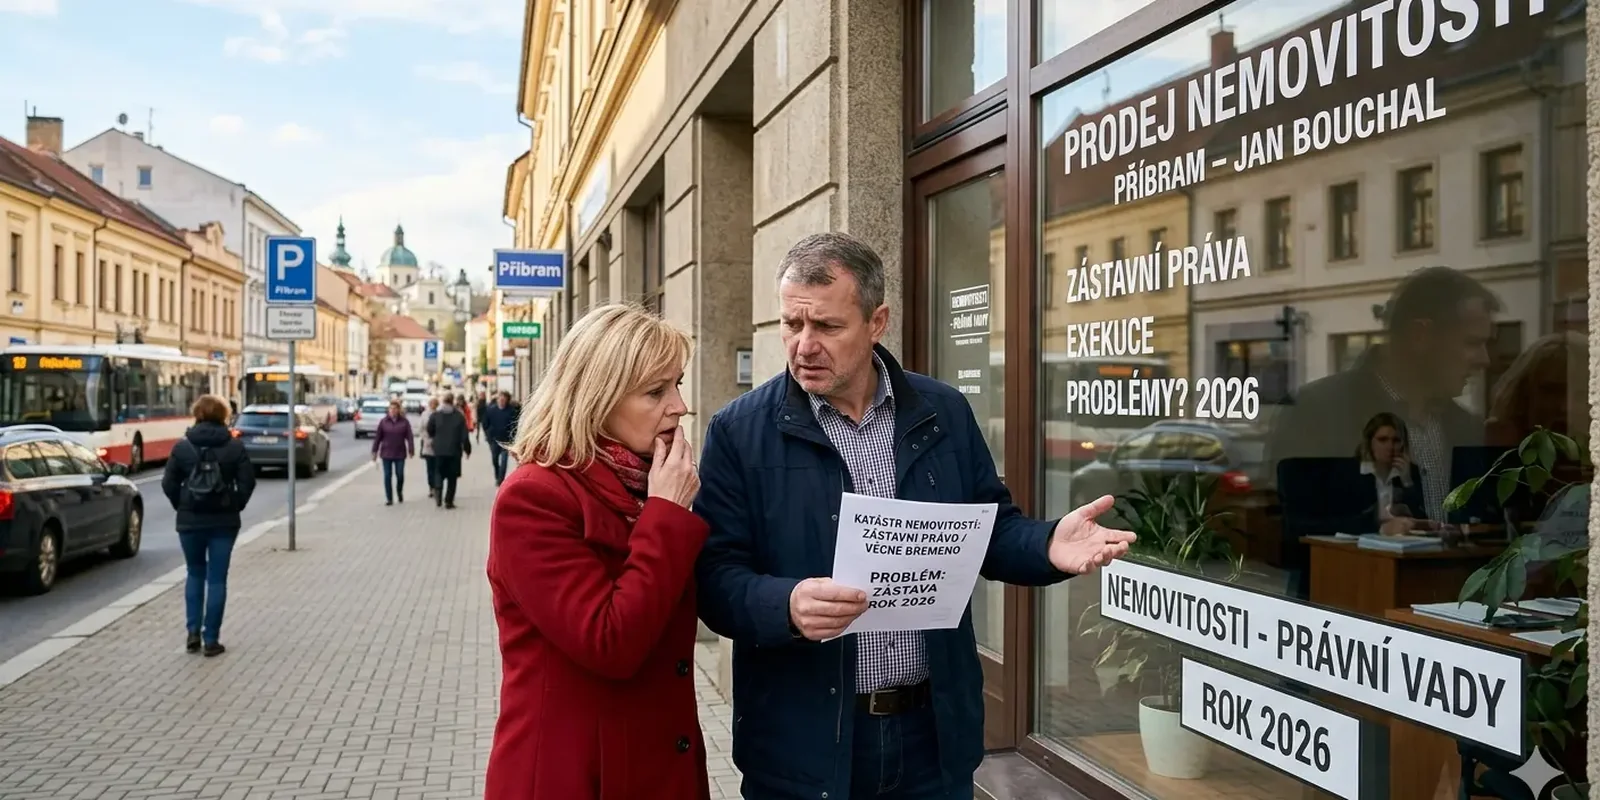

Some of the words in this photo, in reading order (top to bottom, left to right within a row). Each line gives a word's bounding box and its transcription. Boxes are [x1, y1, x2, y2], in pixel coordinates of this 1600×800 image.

[1064, 86, 1176, 174] PRODEJ
[1188, 0, 1544, 131] NEMOVITOS
[1114, 148, 1206, 205] PŘÍBRAM
[1233, 124, 1285, 173] JAN
[1293, 77, 1447, 157] BOUCHAL
[1066, 241, 1162, 304] ZÁSTAVNÍ
[1167, 232, 1251, 286] PRÁVA
[1066, 315, 1155, 359] EXEKUCE
[1066, 369, 1189, 418] PROBLÉMY?
[1195, 376, 1260, 420] 2026
[854, 513, 902, 528] KATÁSTR
[905, 519, 981, 530] NEMOVITOSTÍ:
[921, 531, 959, 543] PRÁVO
[870, 568, 946, 583] PROBLÉM:
[872, 583, 938, 597] ZÁSTAVA
[868, 599, 897, 609] ROK
[901, 596, 936, 607] 2026
[1107, 573, 1249, 650] NEMOVITOSTI
[1277, 619, 1393, 694] PRÁVNÍ
[1401, 652, 1506, 728] VADY
[1202, 681, 1252, 741] ROK
[1260, 706, 1331, 774] 2026
